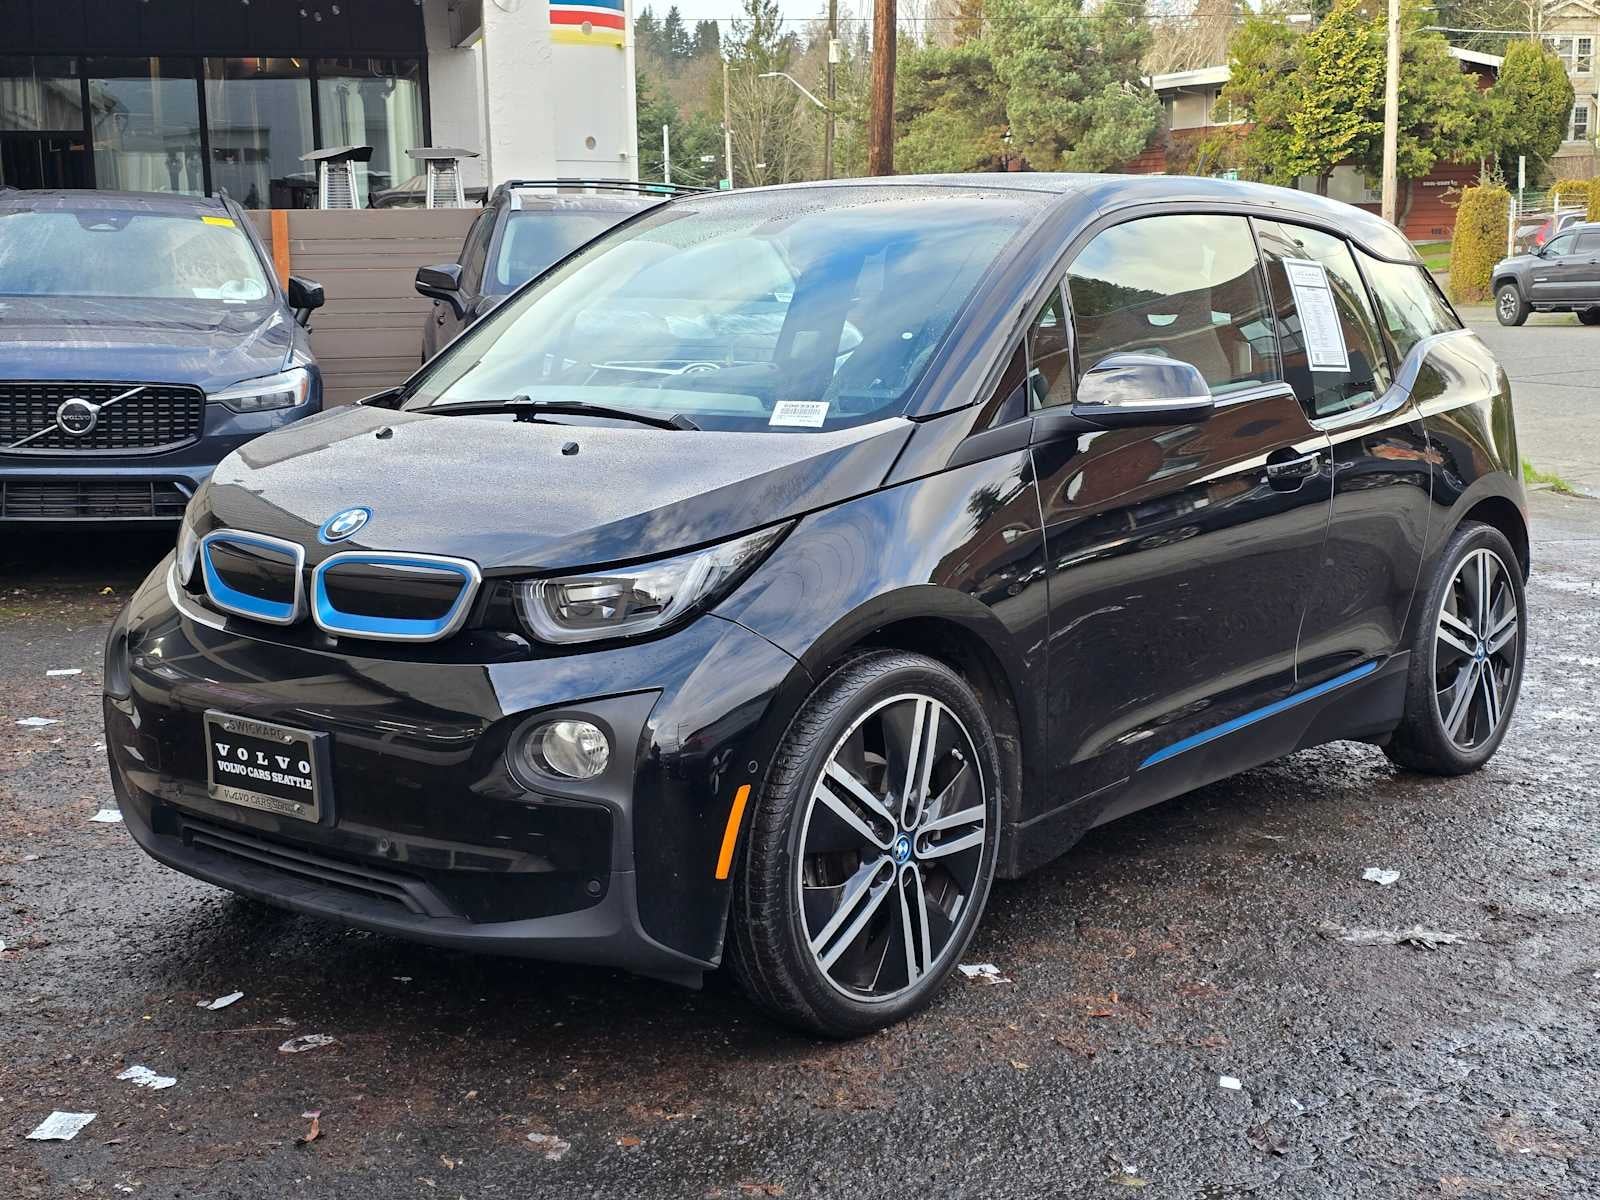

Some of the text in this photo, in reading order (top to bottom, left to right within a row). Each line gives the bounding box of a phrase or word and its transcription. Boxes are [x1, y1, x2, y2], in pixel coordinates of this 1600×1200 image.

[216, 743, 310, 773] VOLVO
[217, 760, 313, 790] VOLVO CARS SEATTLE
